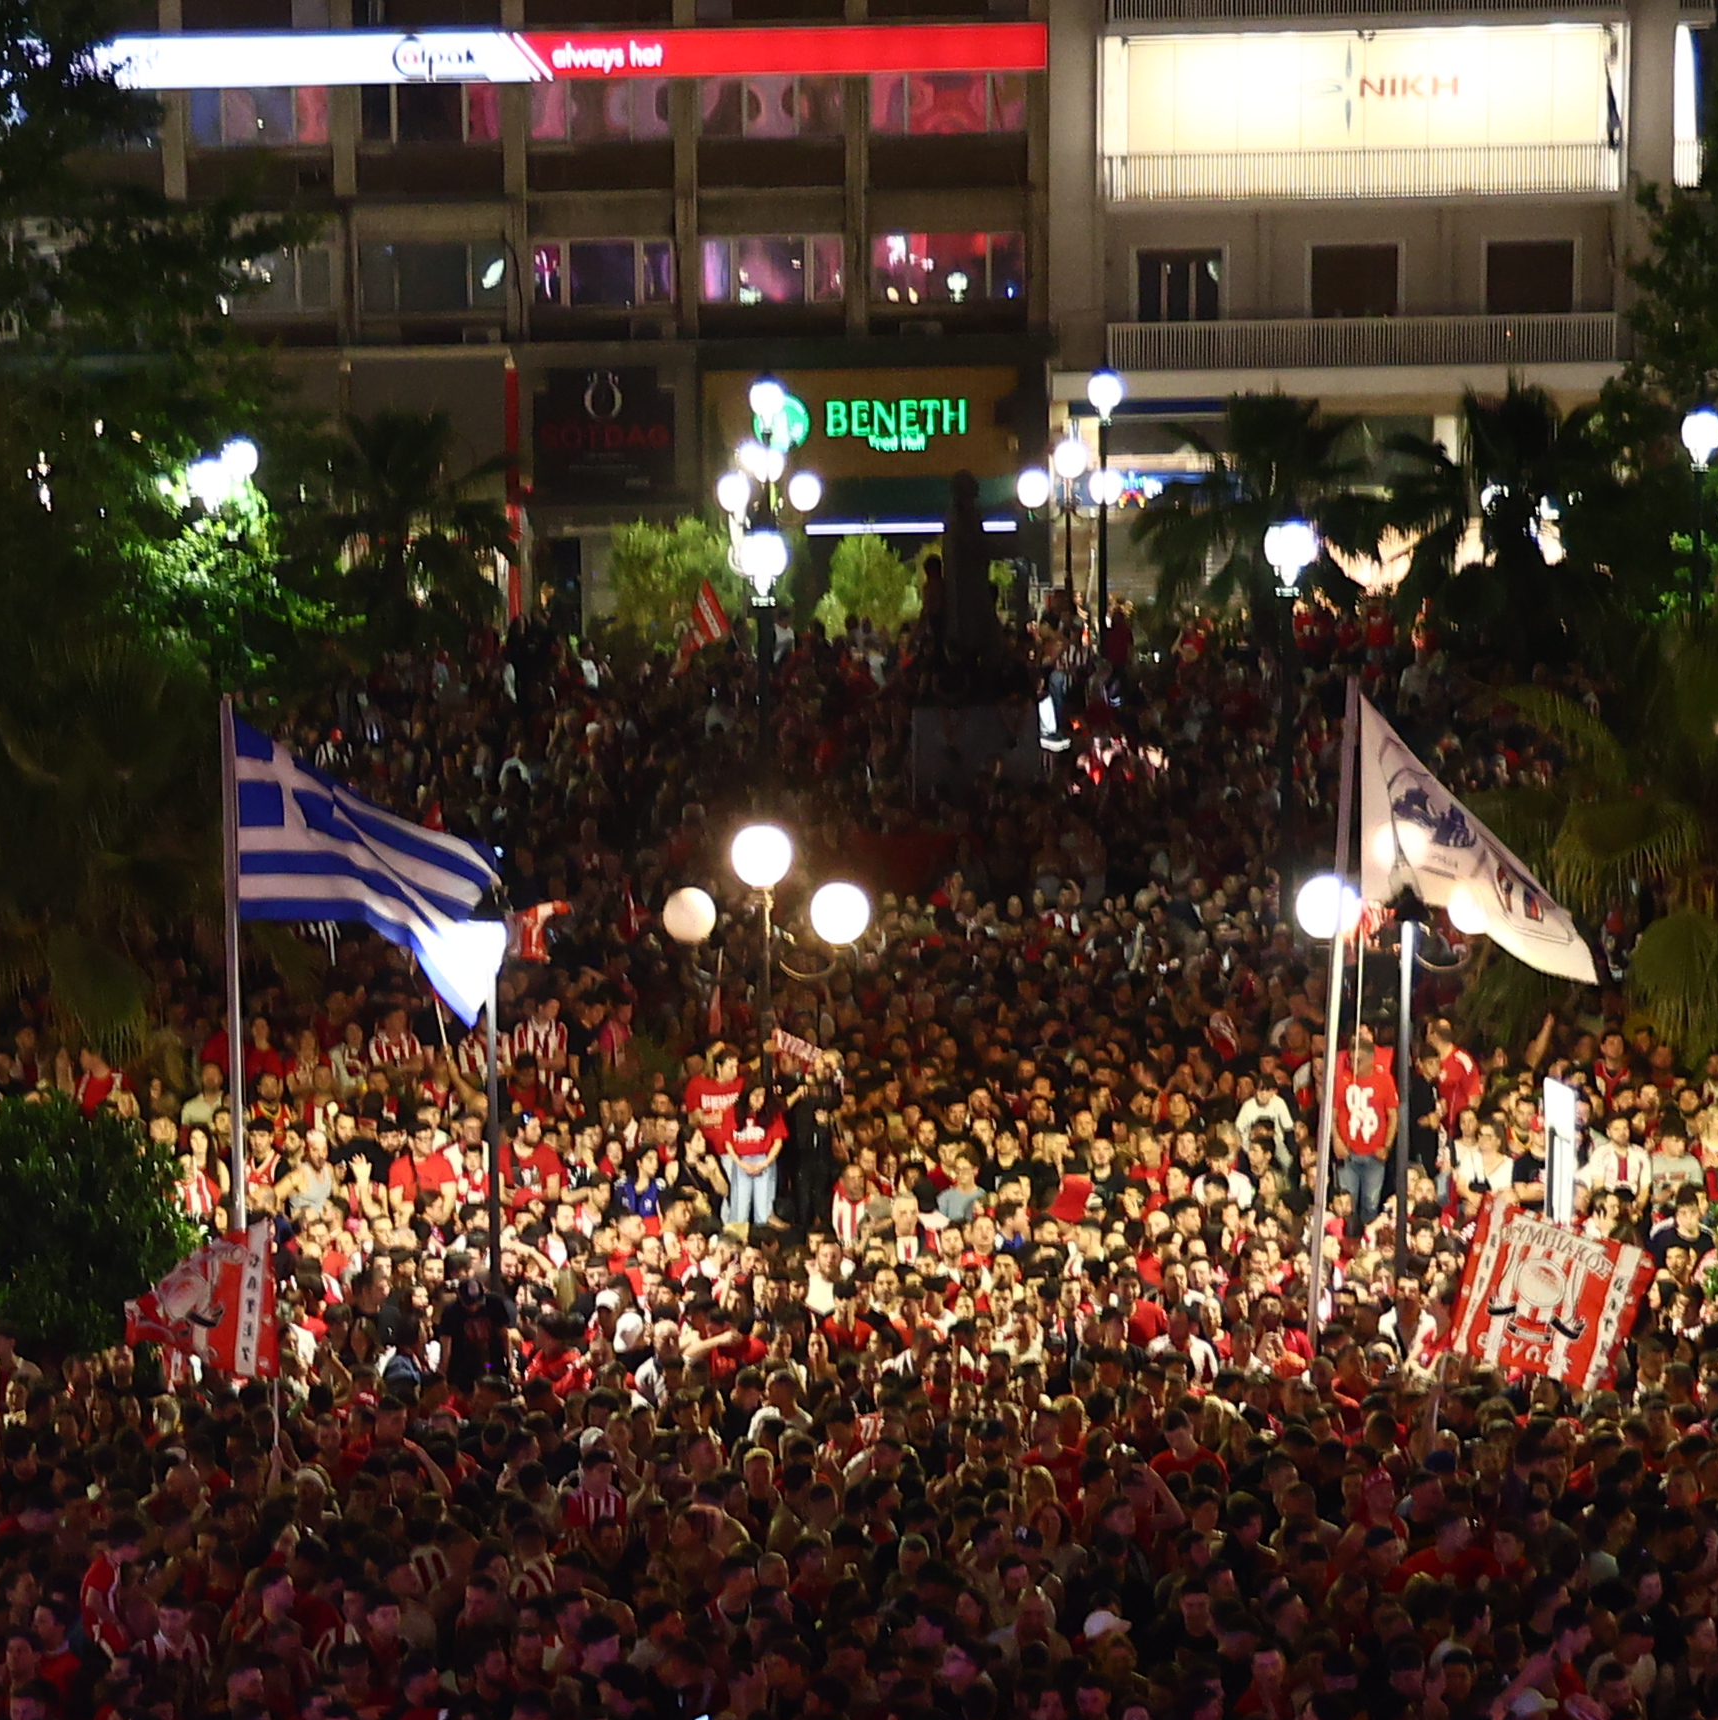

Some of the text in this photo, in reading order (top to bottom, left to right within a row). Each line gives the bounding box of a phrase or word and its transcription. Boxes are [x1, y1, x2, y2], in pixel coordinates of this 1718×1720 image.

[551, 40, 663, 74] always hot
[826, 398, 969, 437] BENETH
